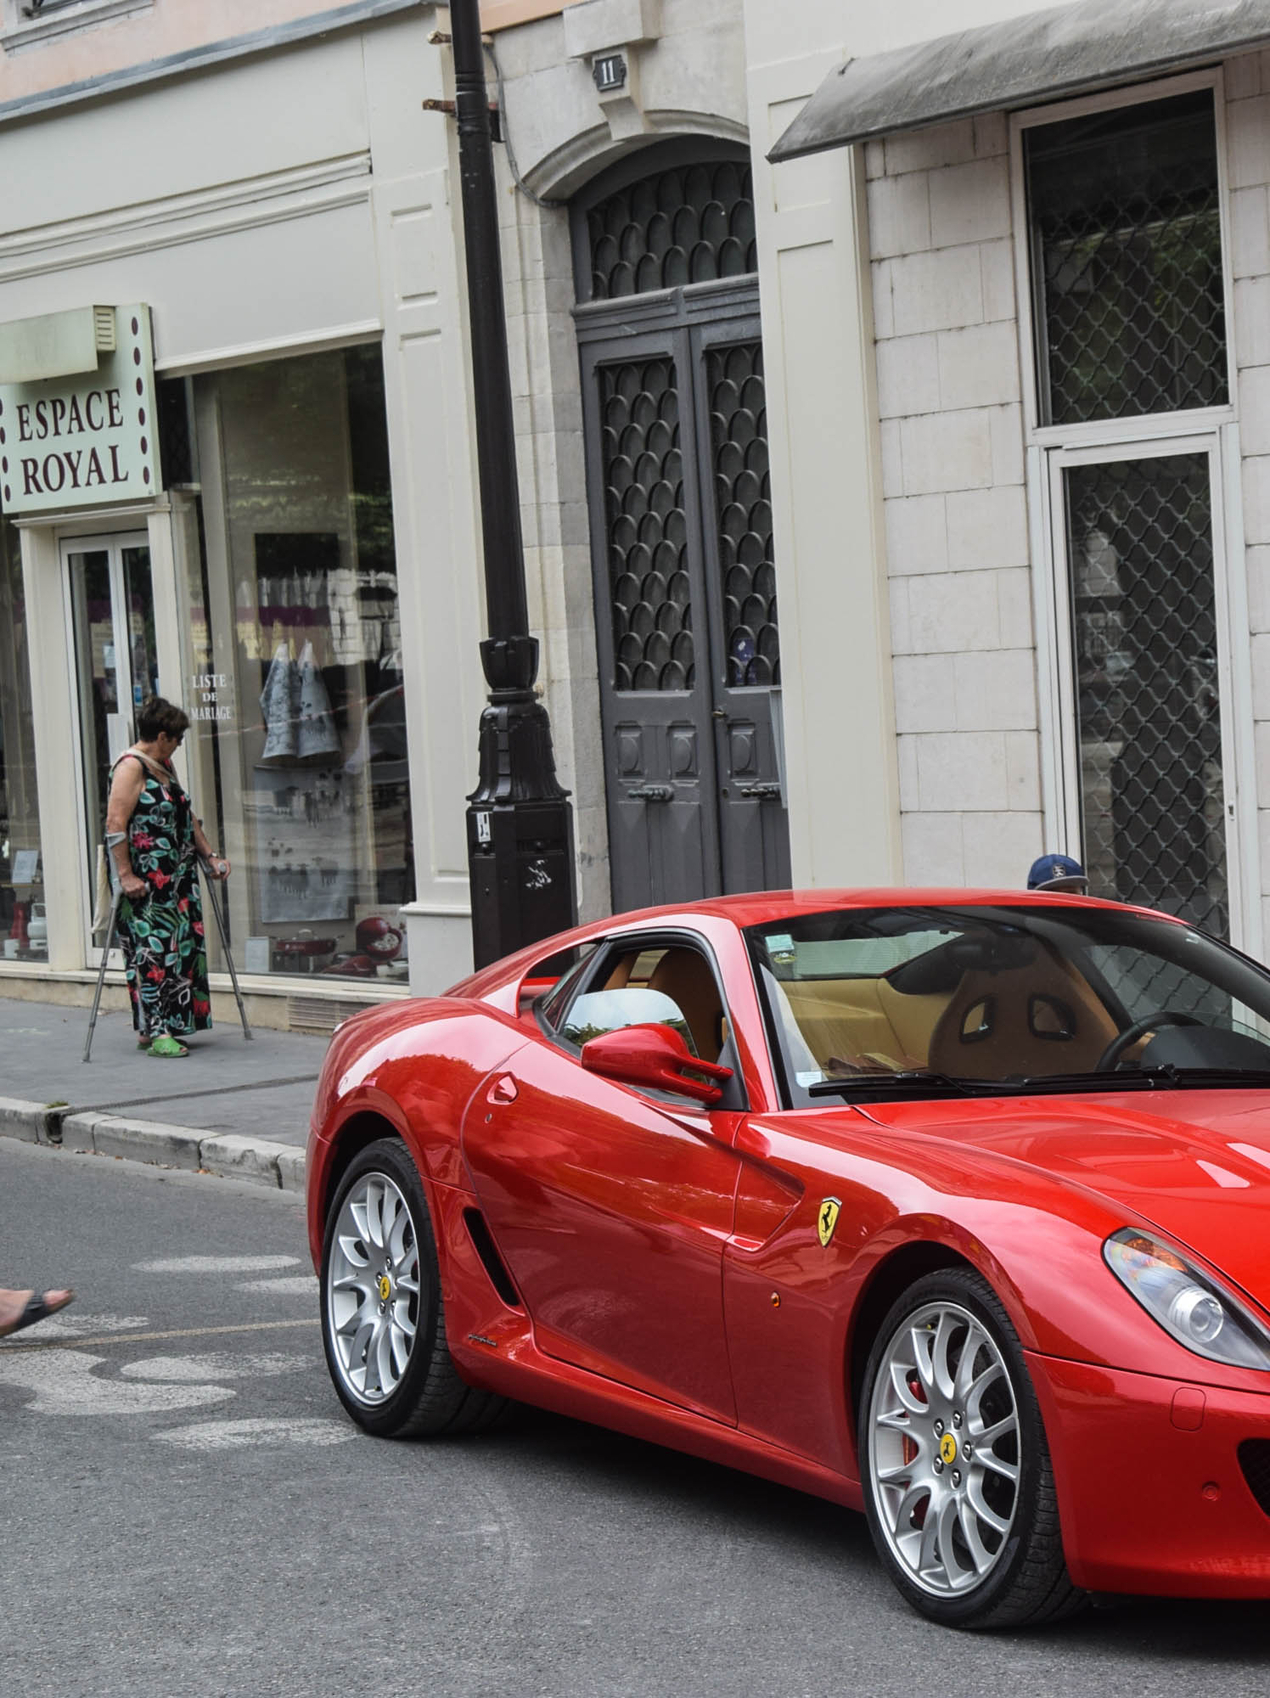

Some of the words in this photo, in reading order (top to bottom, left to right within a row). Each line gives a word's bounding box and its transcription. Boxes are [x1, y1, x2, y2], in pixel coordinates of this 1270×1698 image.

[602, 60, 615, 85] 11
[16, 388, 124, 442] ESPACE
[20, 444, 129, 496] ROYAL
[192, 674, 227, 688] LISTE
[202, 691, 218, 702] DE
[190, 705, 232, 721] MARIAGE
